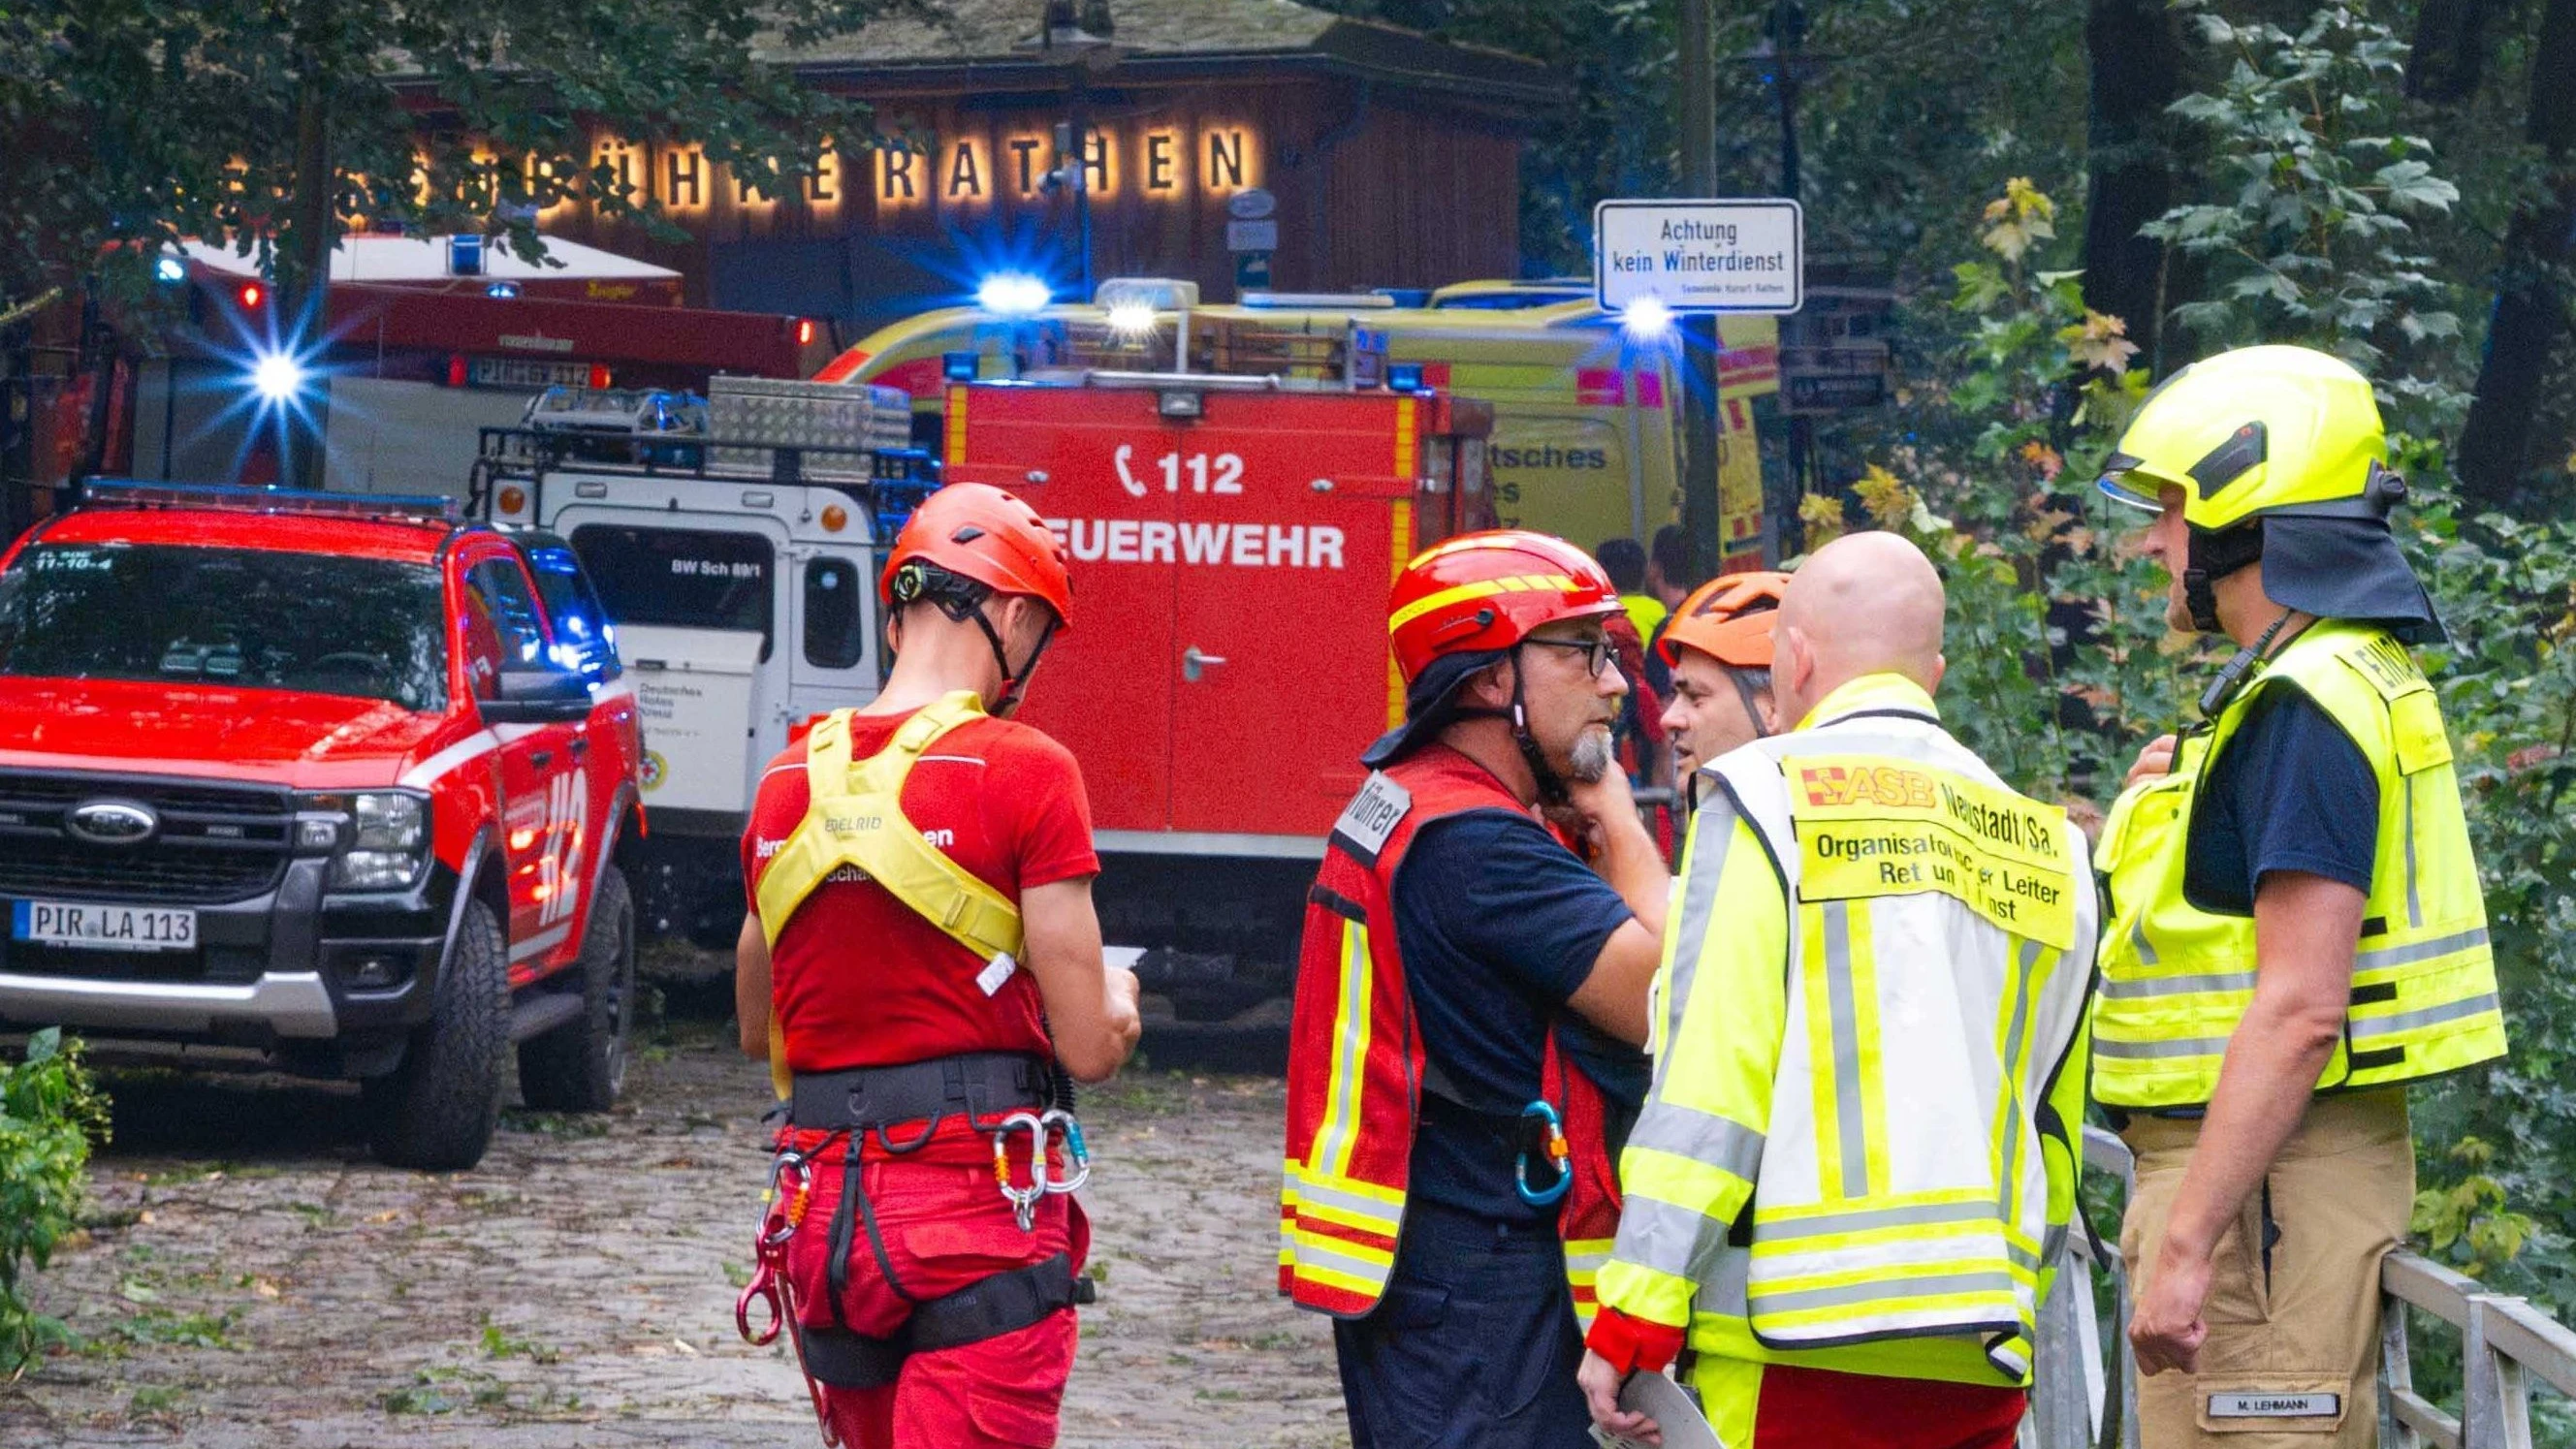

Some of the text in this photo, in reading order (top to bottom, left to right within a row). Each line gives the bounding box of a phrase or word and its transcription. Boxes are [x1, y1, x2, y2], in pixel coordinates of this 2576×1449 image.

[1661, 219, 1737, 245] Achtung
[1613, 250, 1784, 272] kein Winterdienst
[1491, 444, 1606, 469] tsches
[1158, 453, 1244, 494] 112
[1042, 518, 1345, 569] EUERWEHR
[700, 560, 728, 576] Sch
[1842, 767, 1936, 808] ASB
[2004, 870, 2061, 906] Leiter
[36, 906, 190, 941] PIR LA 113
[2238, 1400, 2308, 1411] M. LEHMANN
